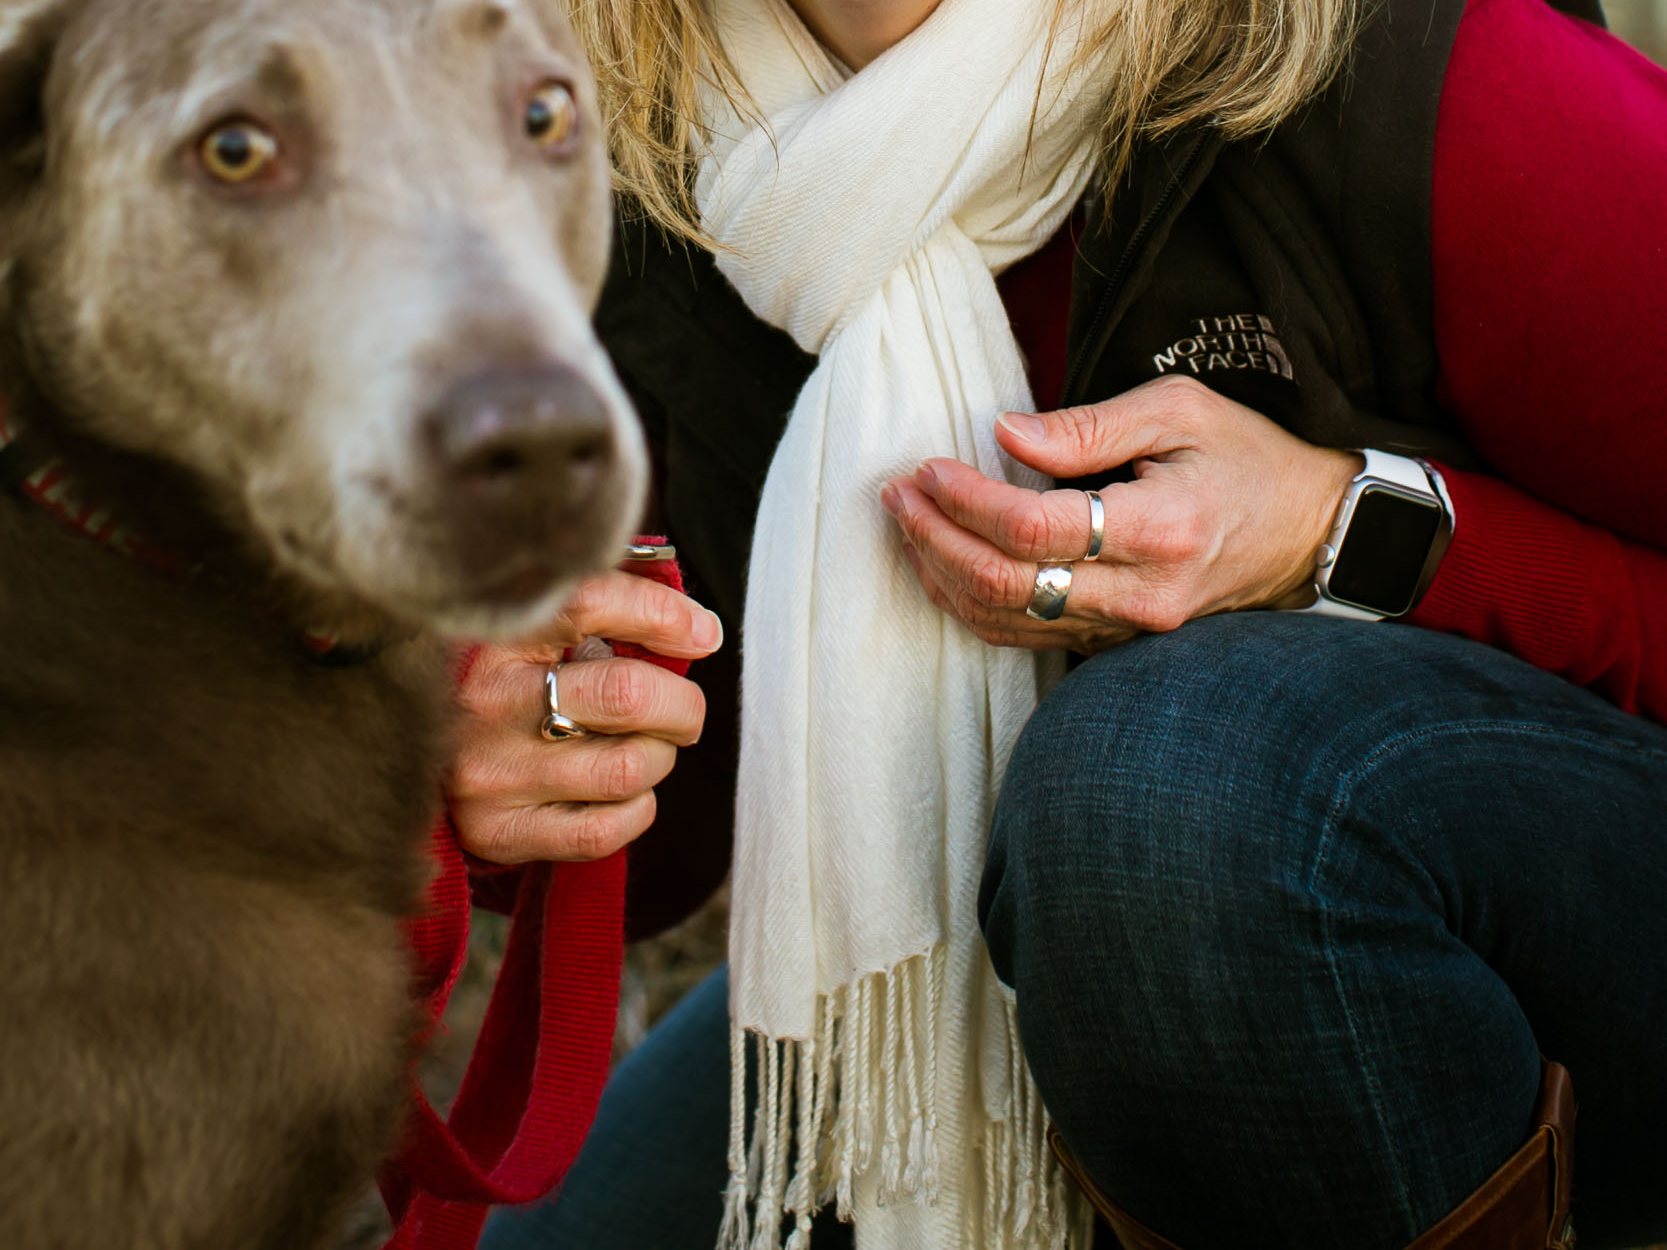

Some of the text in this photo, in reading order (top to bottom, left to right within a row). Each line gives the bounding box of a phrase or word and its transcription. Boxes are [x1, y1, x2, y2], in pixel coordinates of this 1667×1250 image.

[1192, 314, 1257, 334] THE
[1153, 333, 1262, 372] NORTH
[1189, 351, 1266, 372] FACE
